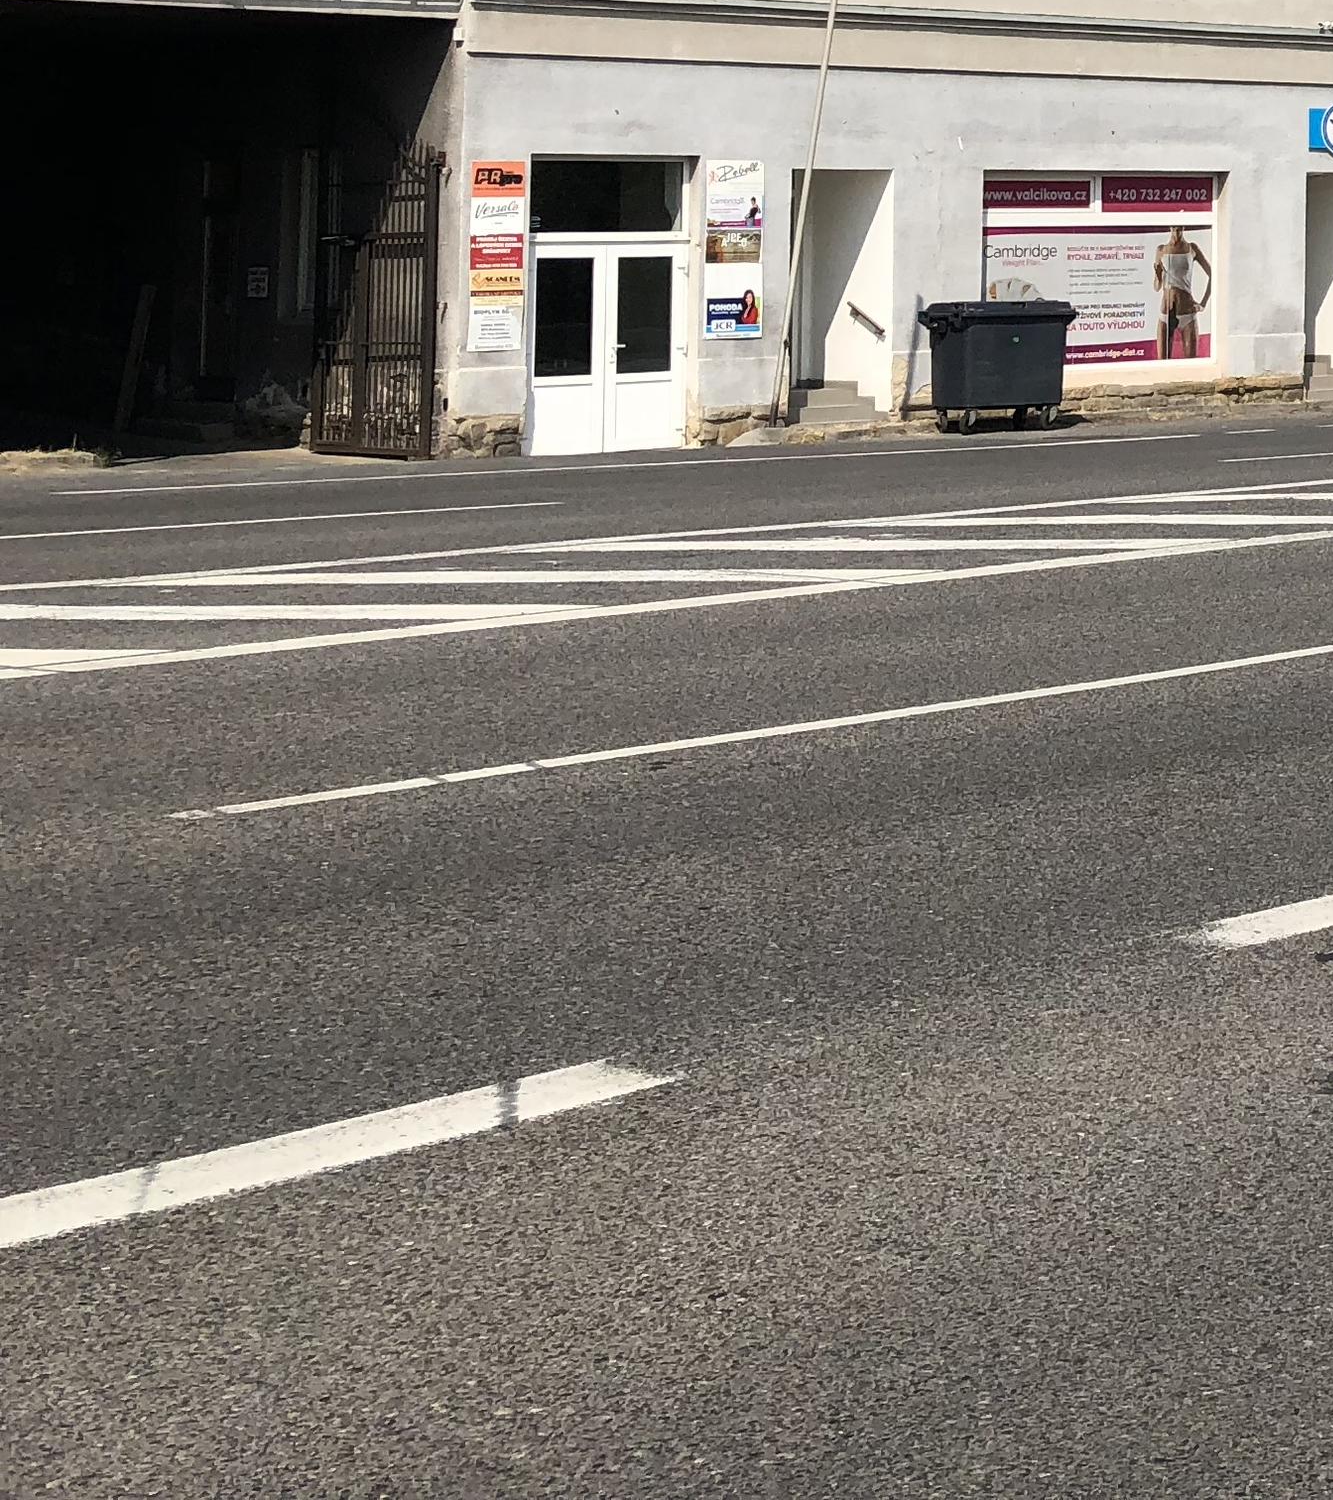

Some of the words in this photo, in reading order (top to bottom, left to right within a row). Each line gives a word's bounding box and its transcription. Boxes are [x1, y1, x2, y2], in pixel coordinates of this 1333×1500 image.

[983, 188, 1087, 200] www.valcikova.cz
[1109, 189, 1136, 200] +420
[1140, 189, 1160, 200] 732
[1163, 189, 1182, 200] 247
[1186, 189, 1207, 200] 002
[984, 244, 1057, 260] Cambridge
[714, 322, 733, 330] JCR
